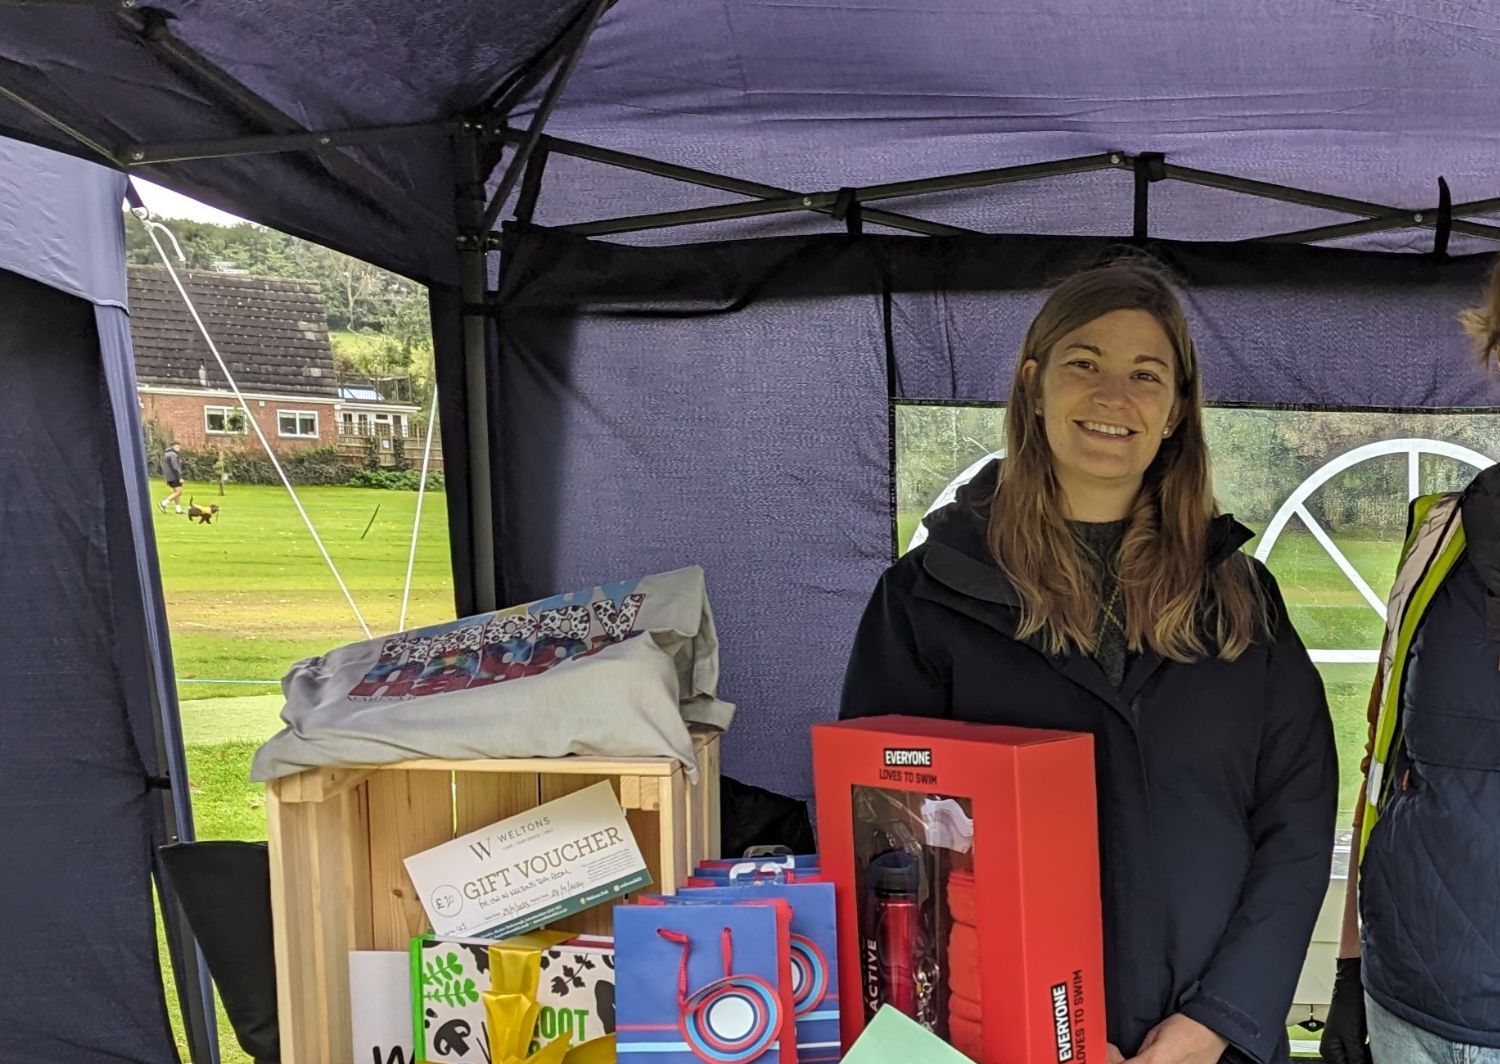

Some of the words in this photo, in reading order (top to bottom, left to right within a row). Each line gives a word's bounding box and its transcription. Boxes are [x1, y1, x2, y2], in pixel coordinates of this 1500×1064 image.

[878, 769, 901, 781] LOVES
[904, 771, 914, 783] TO
[915, 773, 938, 786] SWIM
[885, 751, 931, 767] EVERYONE
[469, 837, 491, 861] W
[497, 815, 552, 843] WELTONS
[462, 867, 512, 901] GIFT
[514, 826, 624, 879] VOUCHER
[867, 938, 877, 1013] ACTIVE
[1072, 969, 1084, 1011] SWIM
[534, 1006, 589, 1041] OOT
[1053, 984, 1072, 1063] EVERYONE
[1075, 1012, 1086, 1031] TO
